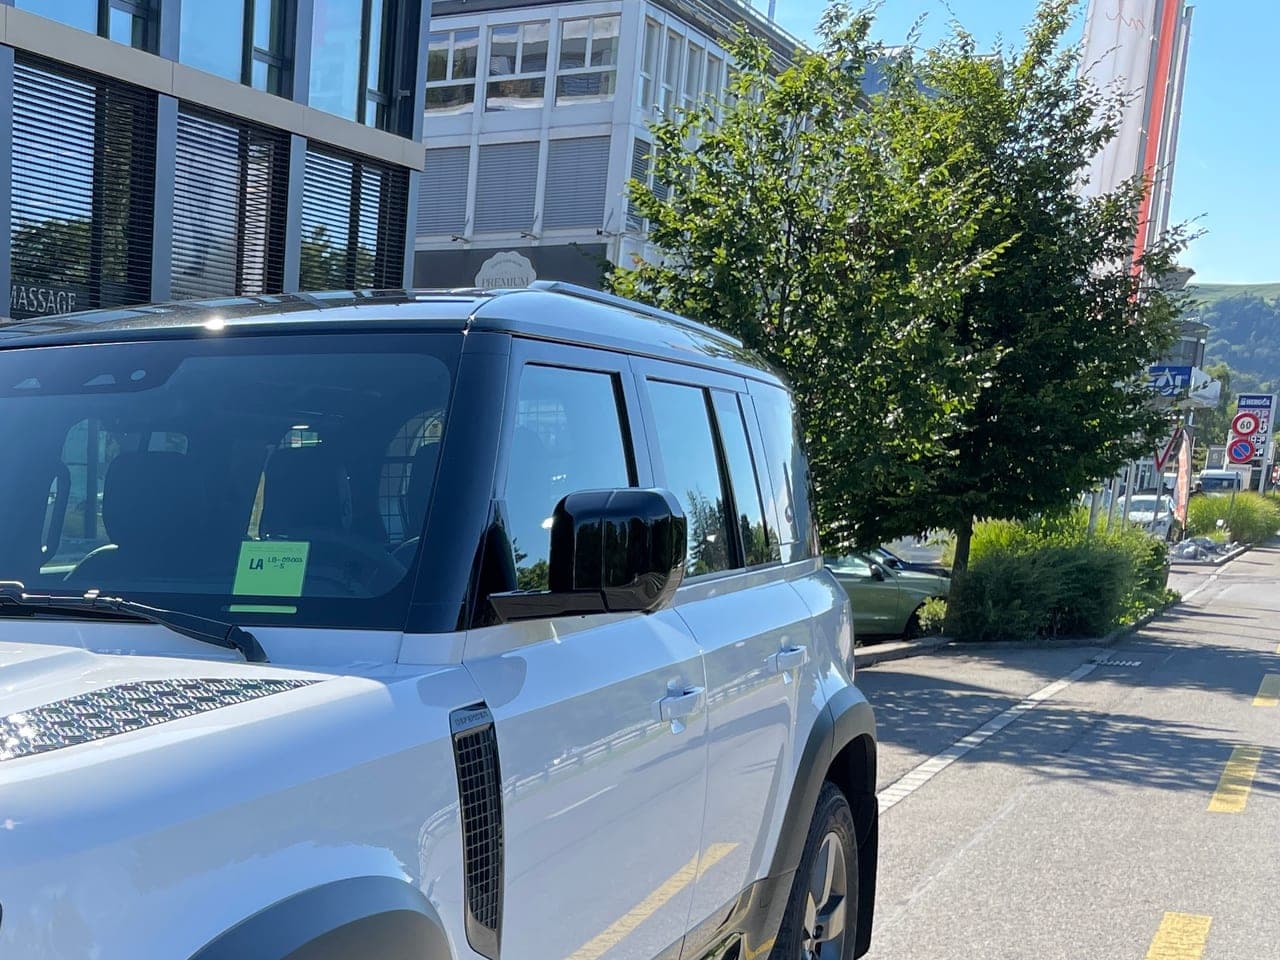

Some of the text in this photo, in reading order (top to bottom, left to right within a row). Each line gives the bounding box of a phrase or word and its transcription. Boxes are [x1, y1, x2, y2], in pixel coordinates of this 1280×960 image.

[482, 276, 529, 288] PREMIUM
[1240, 420, 1252, 430] 60
[249, 558, 264, 570] LA
